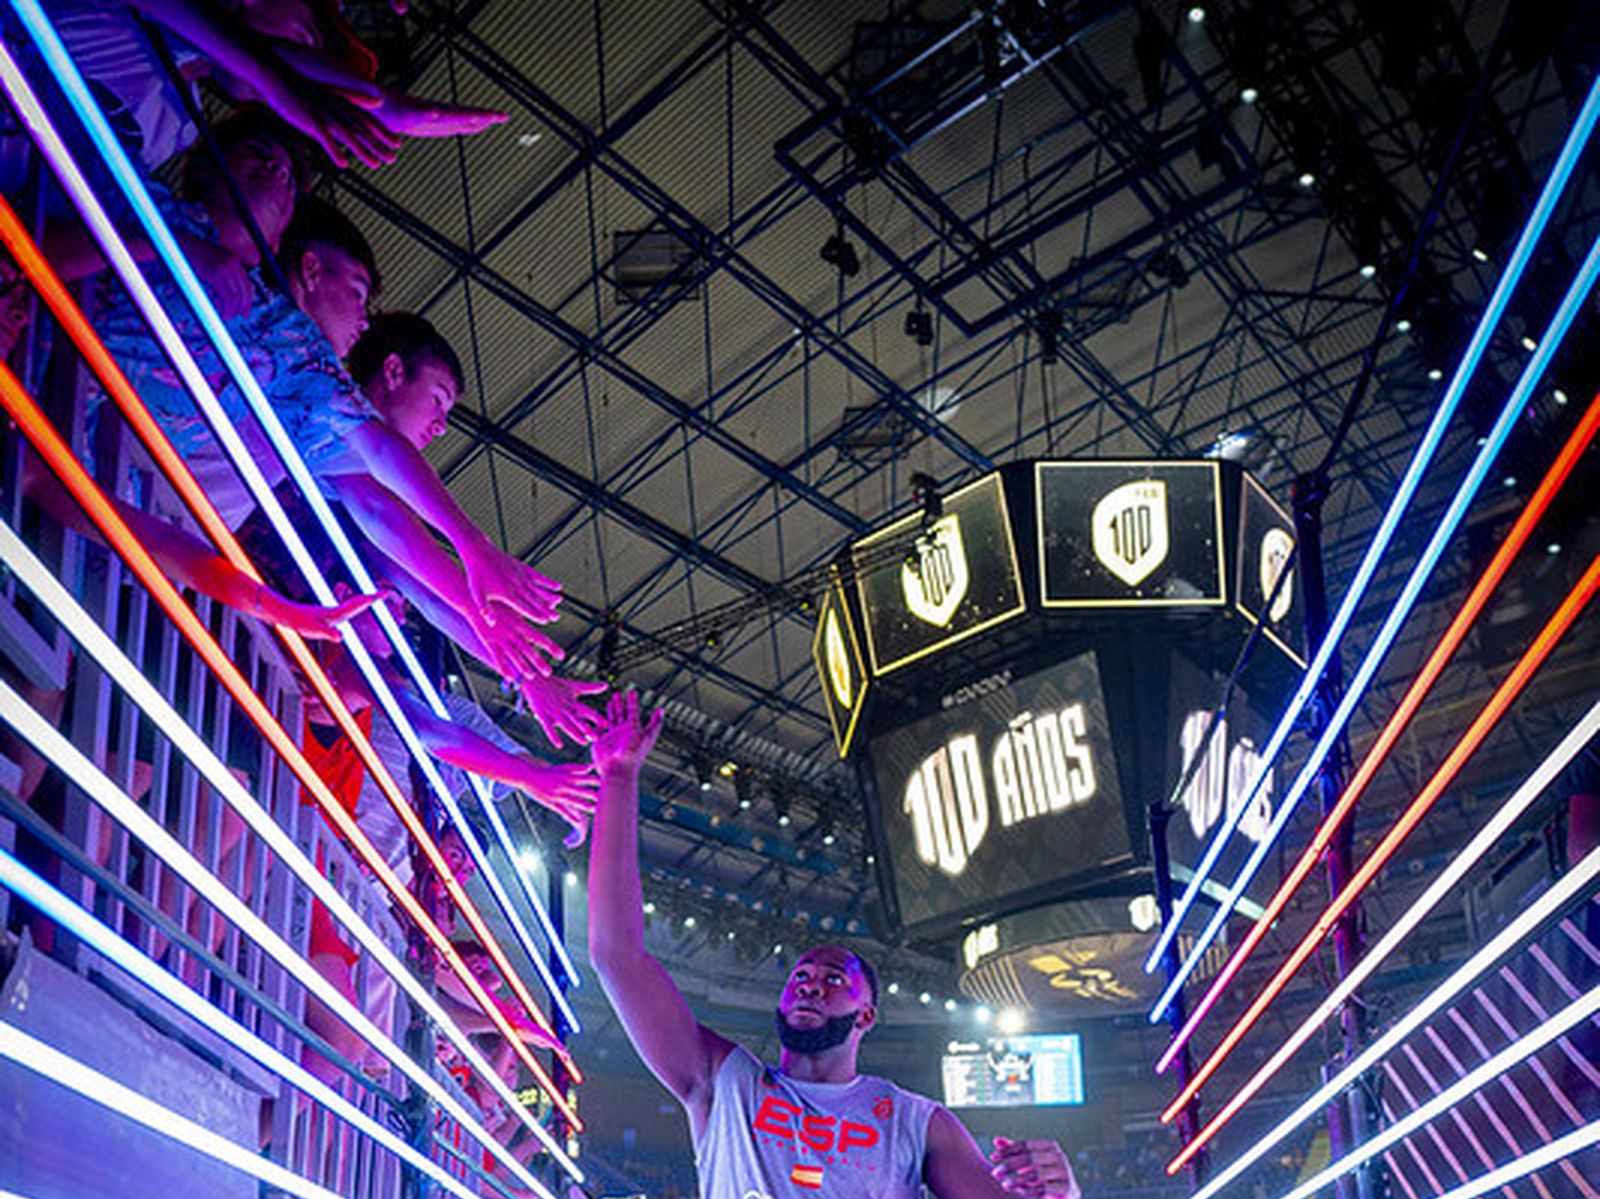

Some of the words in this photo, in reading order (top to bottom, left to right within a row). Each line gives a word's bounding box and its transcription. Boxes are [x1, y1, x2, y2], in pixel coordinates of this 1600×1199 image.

[1109, 505, 1152, 565] 100
[903, 733, 990, 875] 100
[992, 703, 1097, 827] AÑOS
[753, 1095, 880, 1152] ESP
